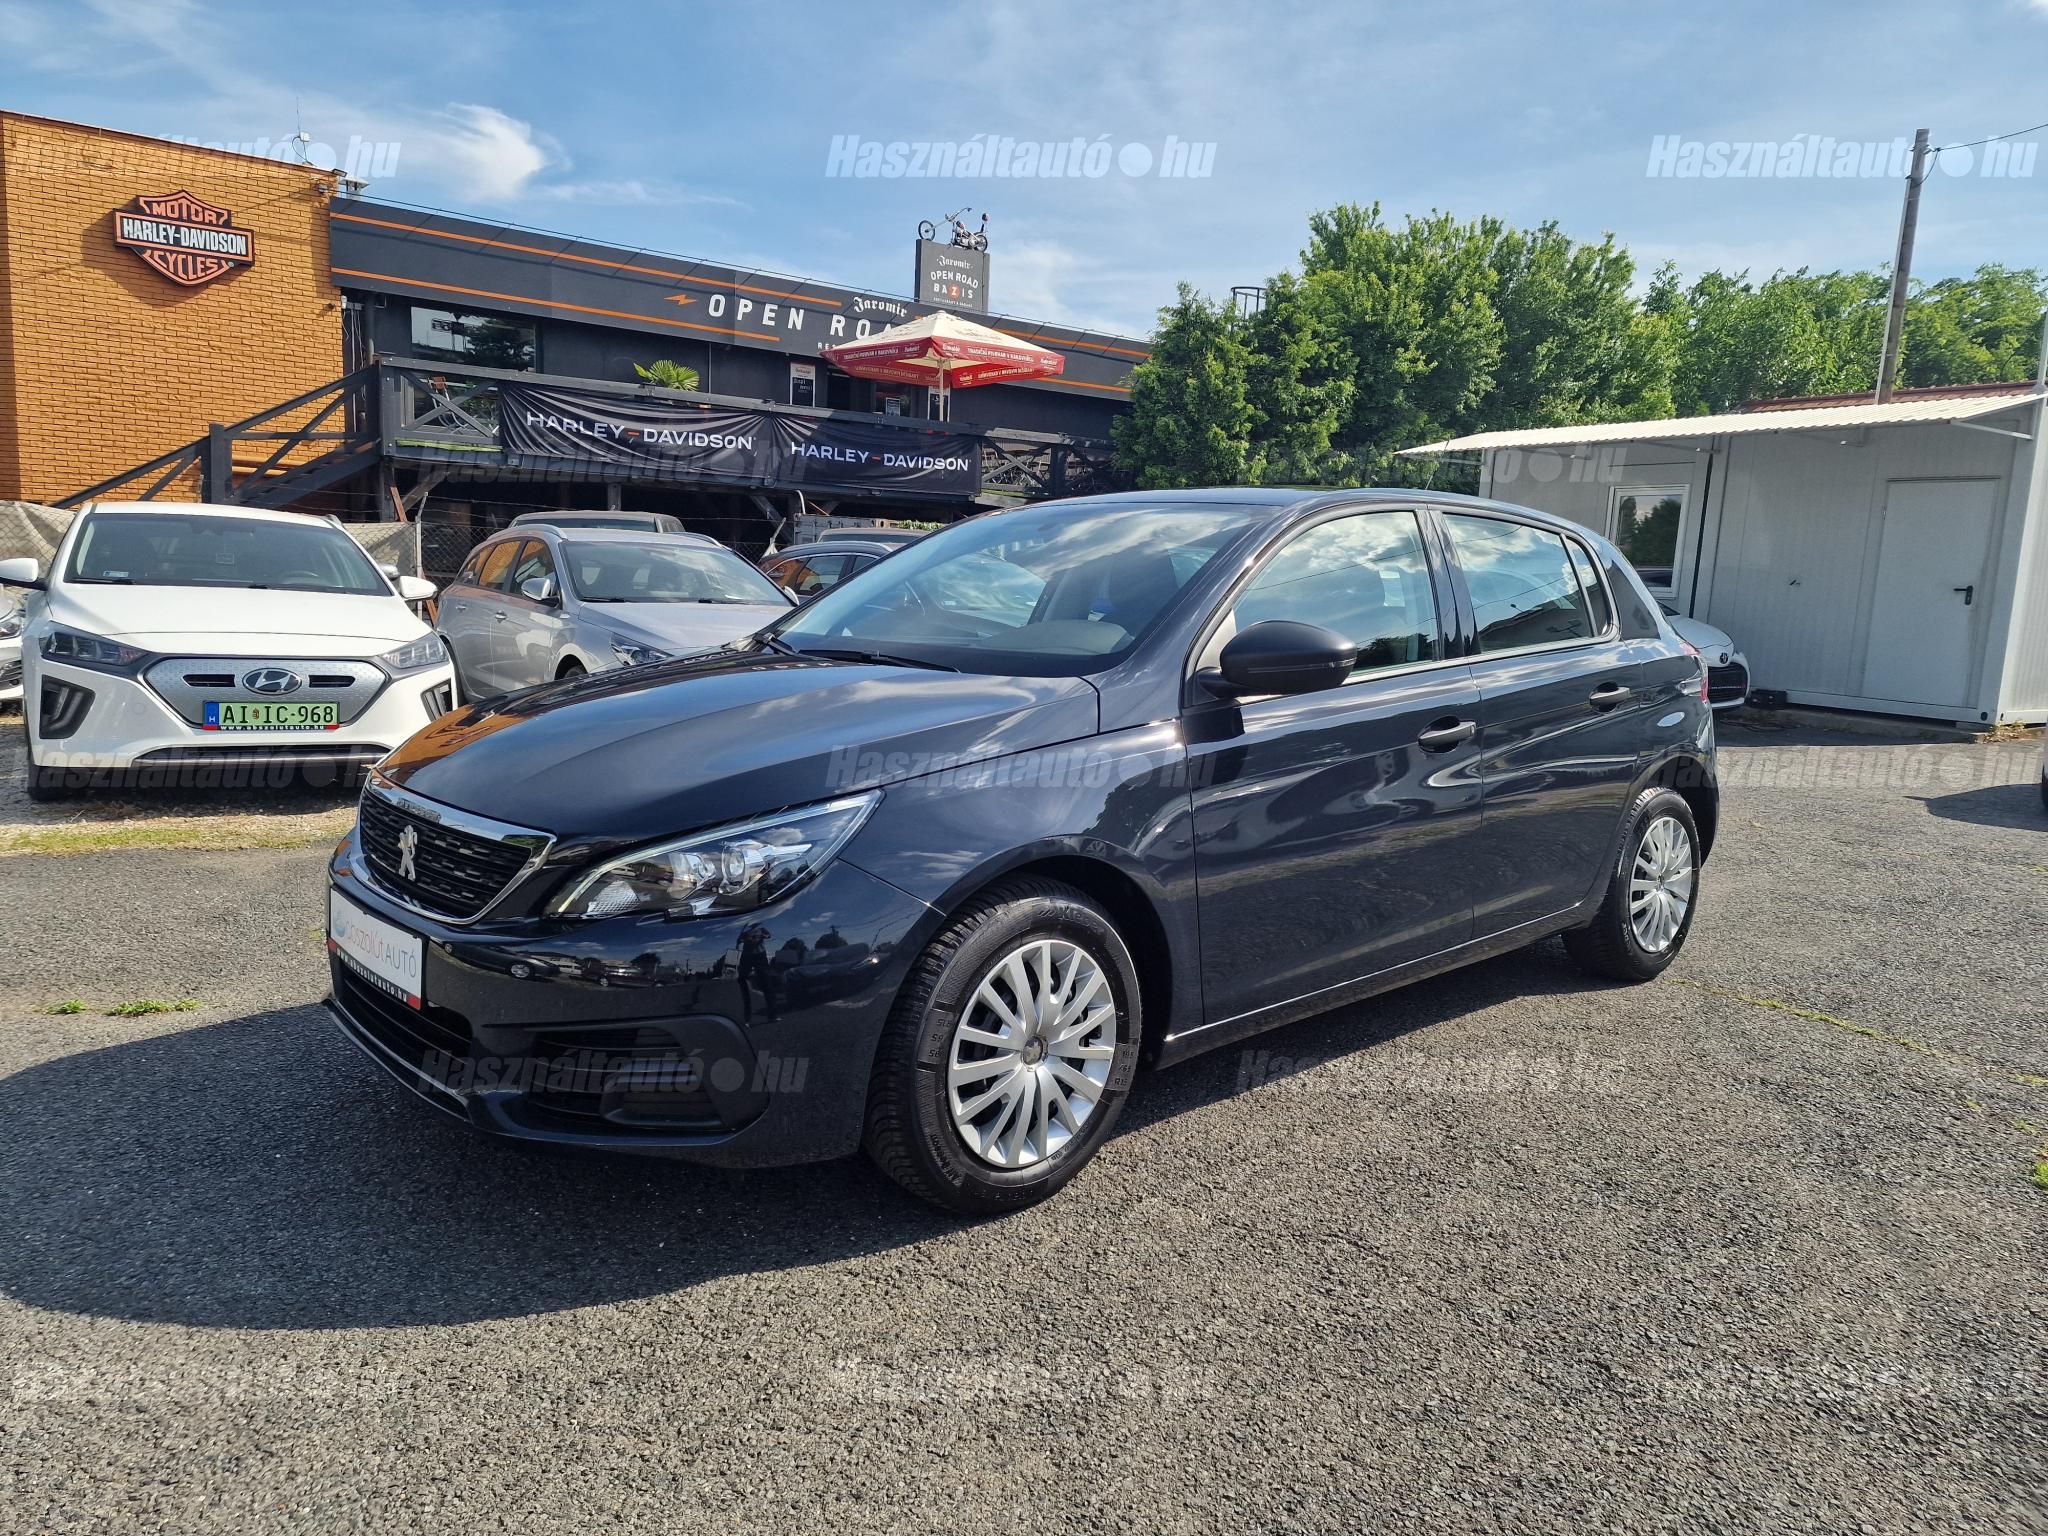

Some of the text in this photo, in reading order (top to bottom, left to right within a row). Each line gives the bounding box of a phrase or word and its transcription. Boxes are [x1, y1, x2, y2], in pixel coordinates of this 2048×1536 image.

[152, 199, 218, 225] MOTOR
[122, 217, 247, 256] HARLEY-DAVIDSON
[153, 250, 219, 280] CYCLES
[930, 270, 979, 289] OPEN ROAD
[708, 294, 805, 330] OPEN
[853, 296, 908, 318] Jaromir
[222, 705, 334, 724] AI IC-968
